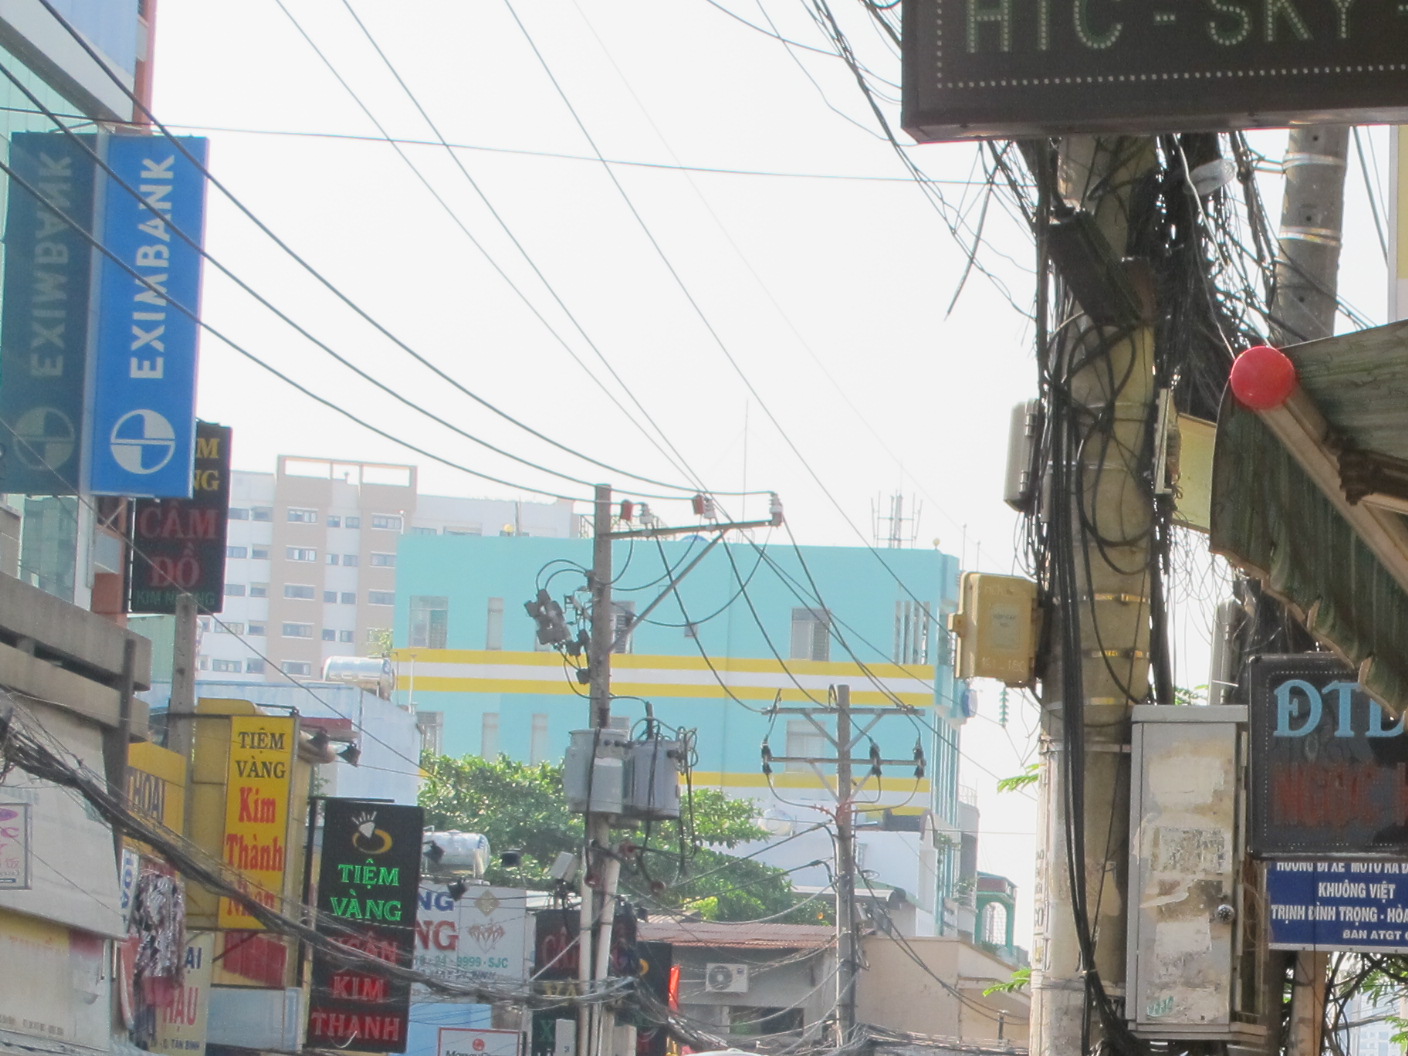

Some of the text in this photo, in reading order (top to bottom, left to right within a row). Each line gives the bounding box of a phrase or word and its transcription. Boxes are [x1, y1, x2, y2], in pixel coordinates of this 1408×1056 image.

[129, 154, 176, 380] EXIMBANK
[238, 727, 286, 755] TIỆM
[235, 755, 287, 779] VÀNG
[238, 786, 277, 824] Kim
[226, 833, 284, 872] Thành
[337, 858, 400, 890] TIỆM
[329, 888, 402, 922] VÀNG
[1318, 879, 1396, 903] KHUÔNG VIỆT
[1271, 904, 1306, 924] TRỊNH
[1338, 907, 1378, 926] TRỌNG
[1342, 929, 1368, 940] BAN
[1370, 930, 1402, 941] ATGT
[332, 975, 385, 1002] KIM
